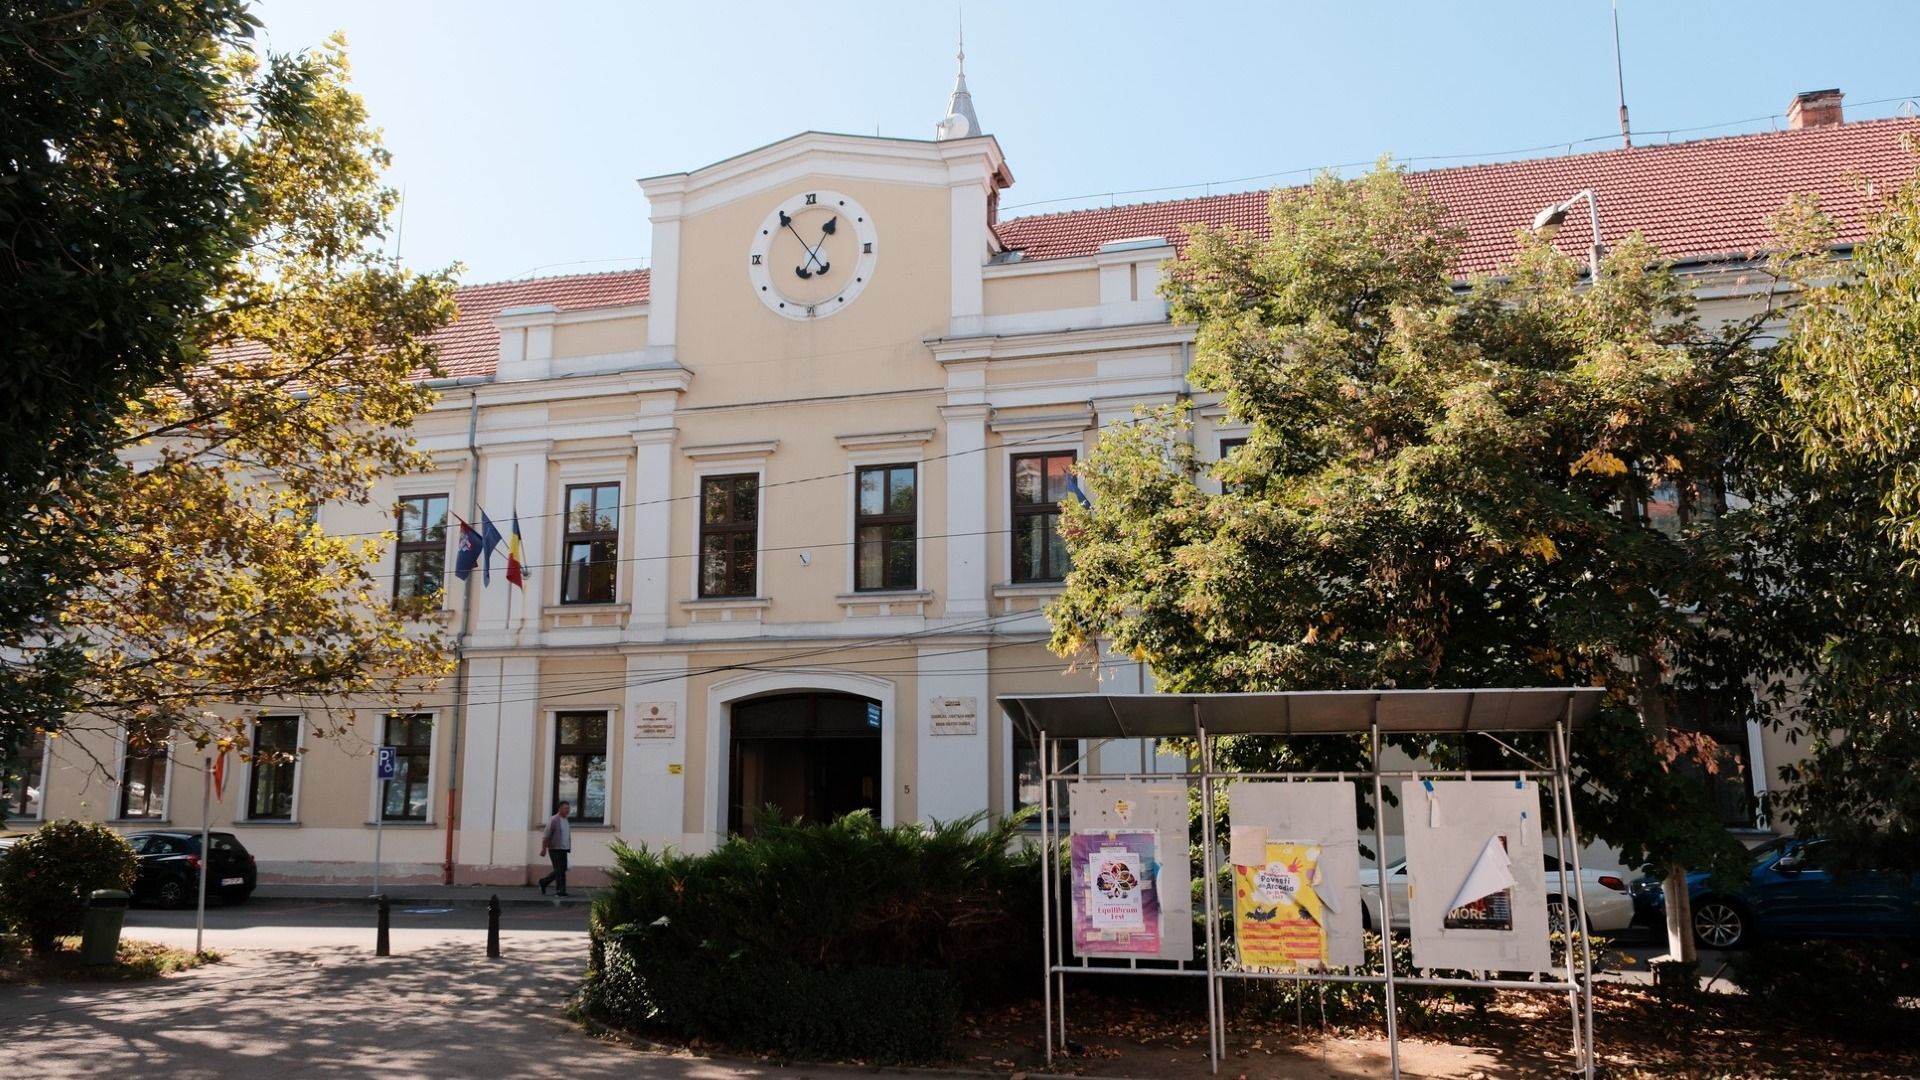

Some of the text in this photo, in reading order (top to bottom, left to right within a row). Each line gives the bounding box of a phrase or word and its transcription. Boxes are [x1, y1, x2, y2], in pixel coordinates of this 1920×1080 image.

[752, 255, 761, 265] IX
[379, 750, 389, 766] P
[904, 784, 910, 794] 5
[1448, 908, 1487, 920] MORE
